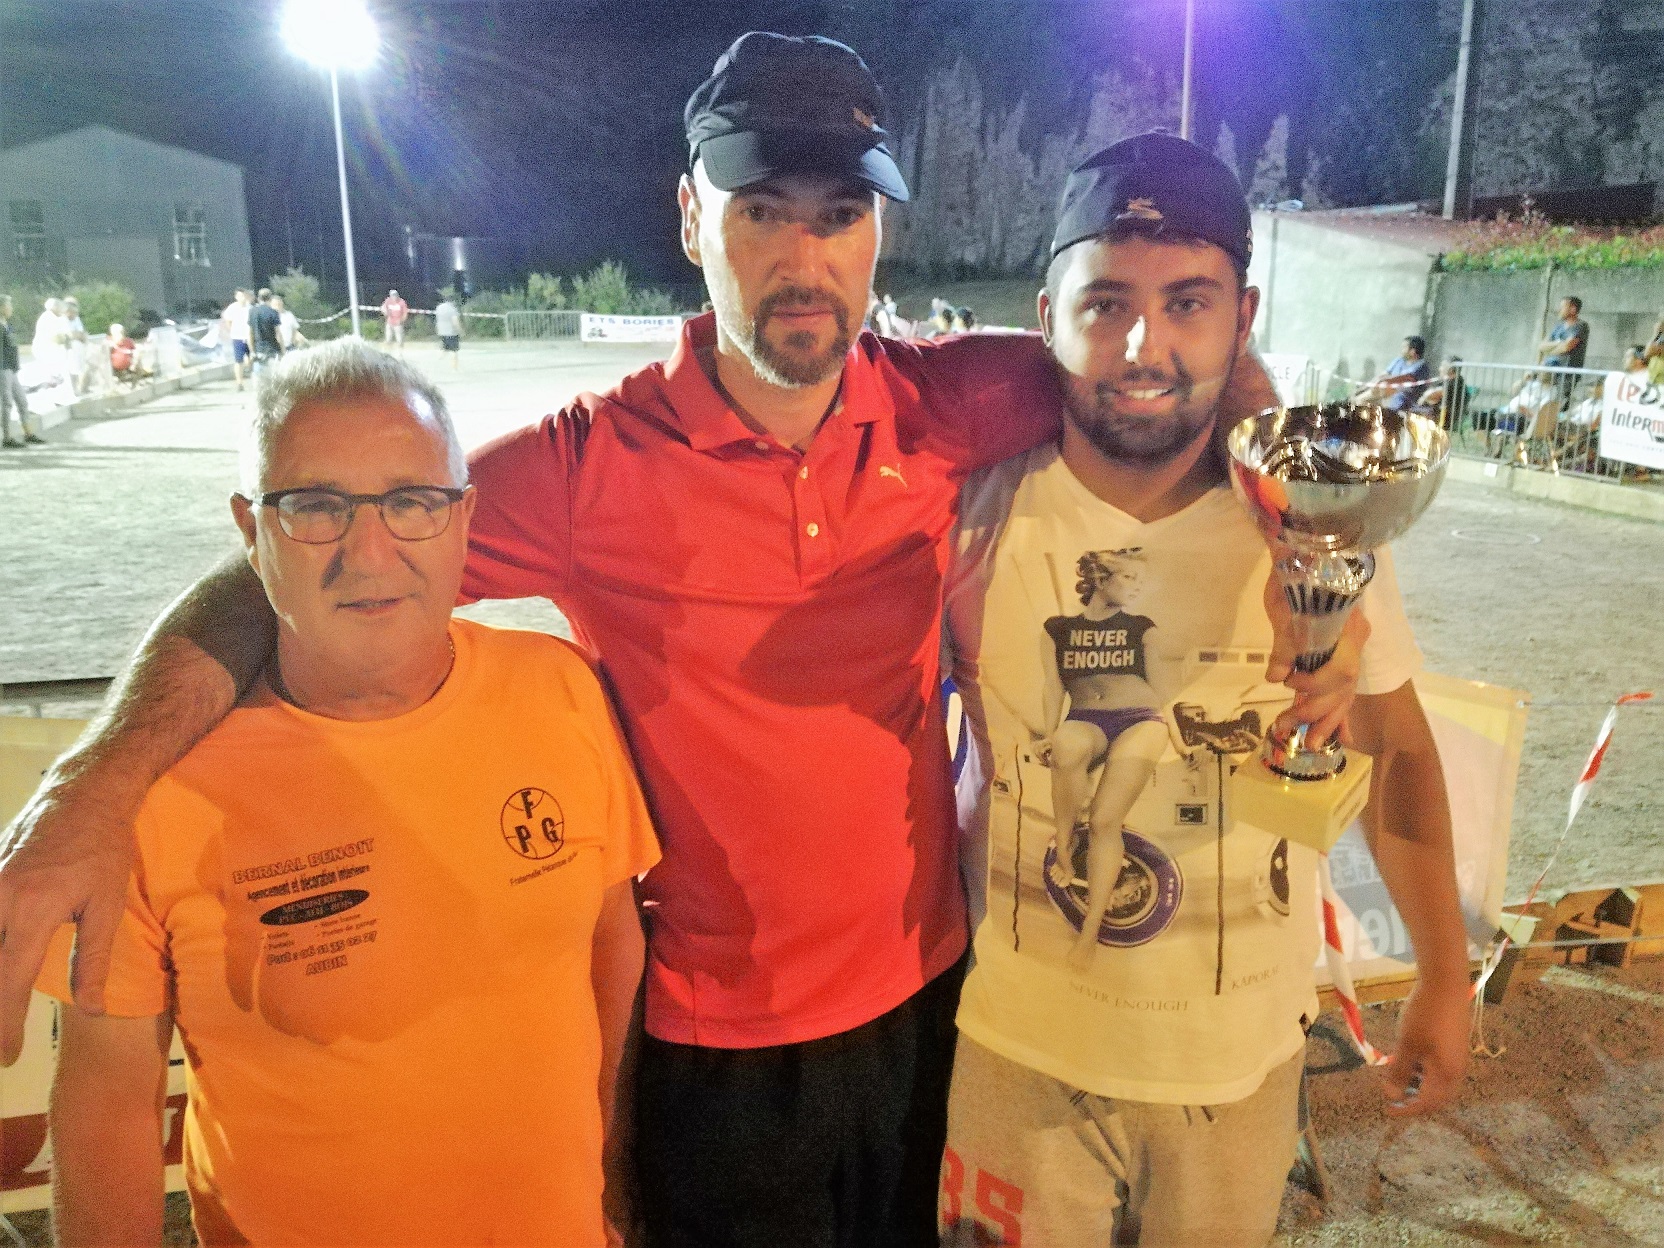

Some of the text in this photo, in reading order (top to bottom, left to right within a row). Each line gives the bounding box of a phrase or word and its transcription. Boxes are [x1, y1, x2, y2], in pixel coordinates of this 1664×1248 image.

[1070, 629, 1128, 647] NEVER
[1063, 649, 1135, 669] ENOUGH
[521, 791, 533, 819] F
[232, 838, 375, 885] BERNAL BENOIT
[305, 954, 348, 976] AUBIN
[1115, 997, 1188, 1012] ENOUGH
